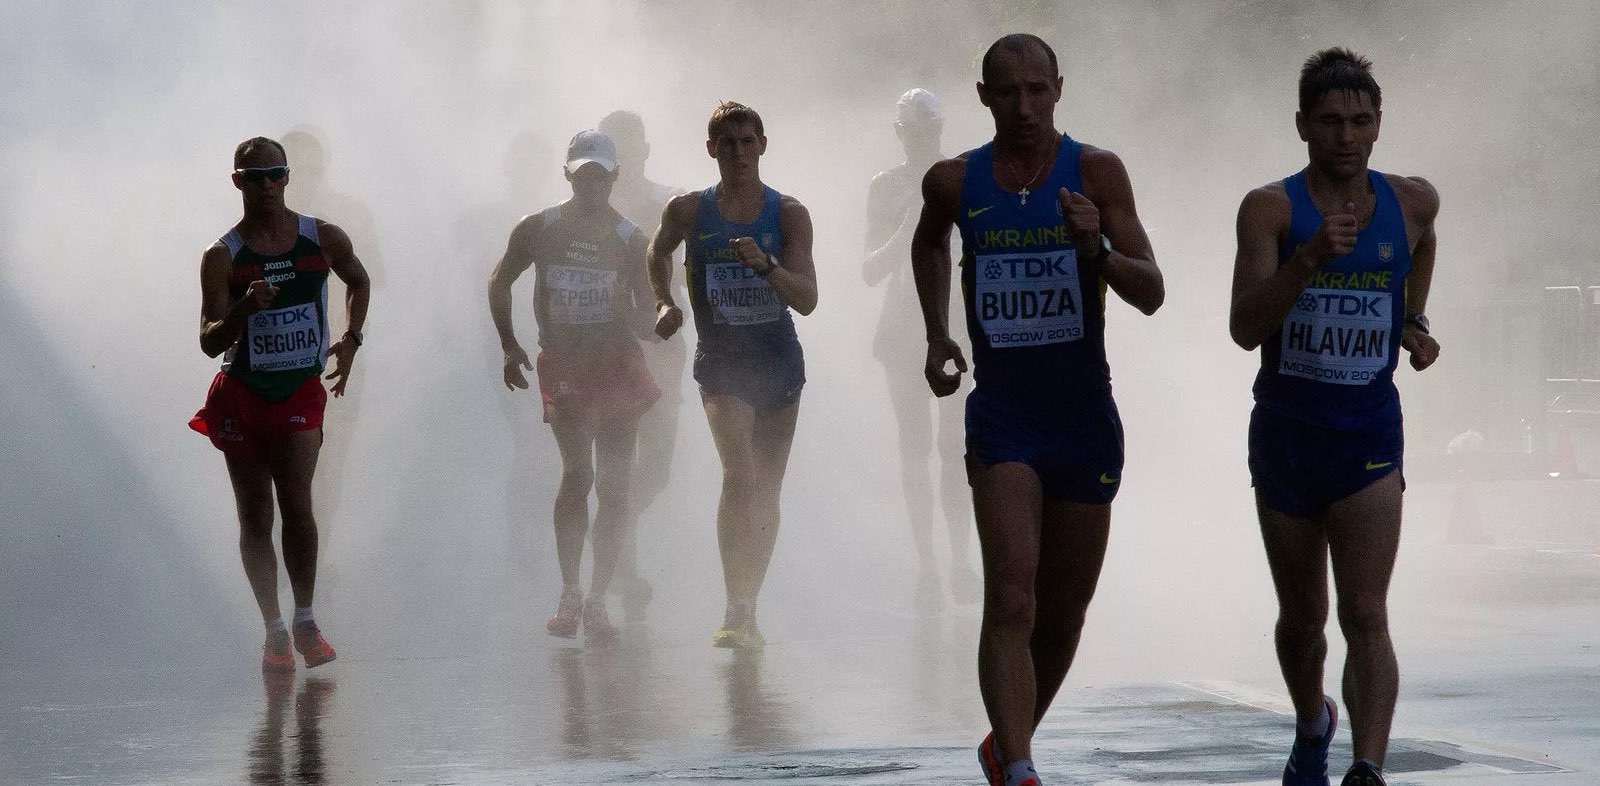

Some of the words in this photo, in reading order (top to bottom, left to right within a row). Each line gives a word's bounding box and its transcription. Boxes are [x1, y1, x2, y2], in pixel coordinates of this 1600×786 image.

[974, 225, 1072, 249] UKRAINE
[1002, 255, 1069, 279] TDK
[982, 287, 1077, 320] BUDZA
[1318, 294, 1382, 317] TDK
[266, 306, 310, 328] TDK
[253, 328, 318, 355] SEGURA
[988, 331, 1044, 344] OSCOW
[1047, 327, 1081, 339] 2013
[1287, 320, 1385, 358] HLAVAN
[253, 359, 297, 370] MOSCOW
[300, 355, 316, 366] 20
[1283, 361, 1349, 380] MOSCOW
[1351, 371, 1376, 381] 20
